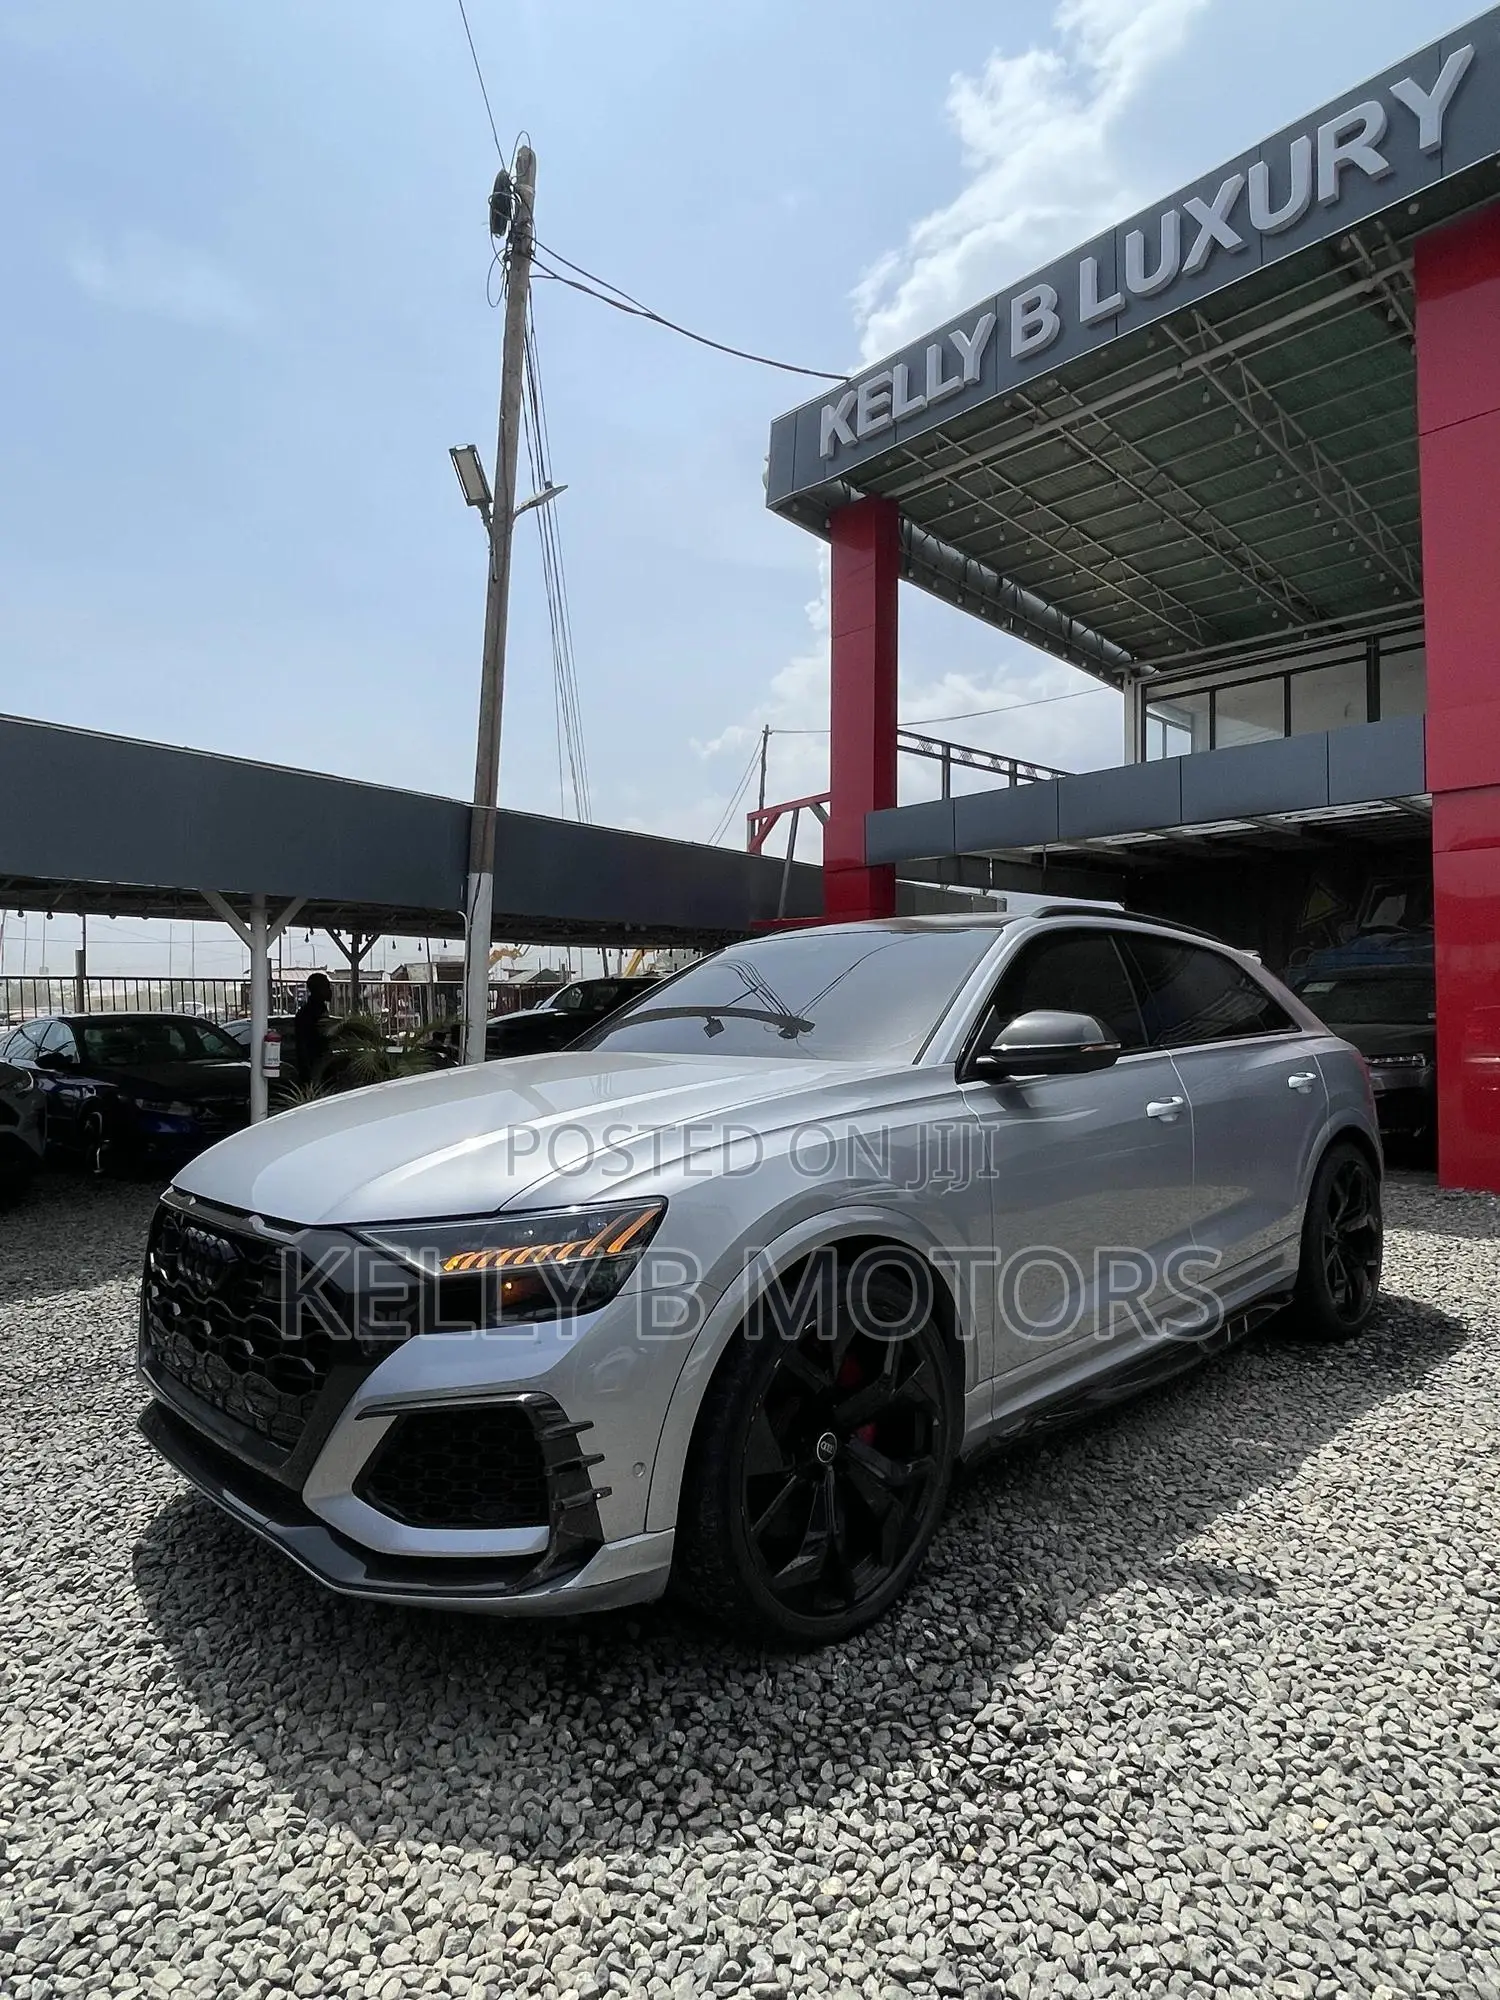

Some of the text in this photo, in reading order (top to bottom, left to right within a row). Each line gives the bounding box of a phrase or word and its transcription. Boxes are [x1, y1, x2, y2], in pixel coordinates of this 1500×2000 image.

[819, 43, 1475, 459] KELLY B LUXURY
